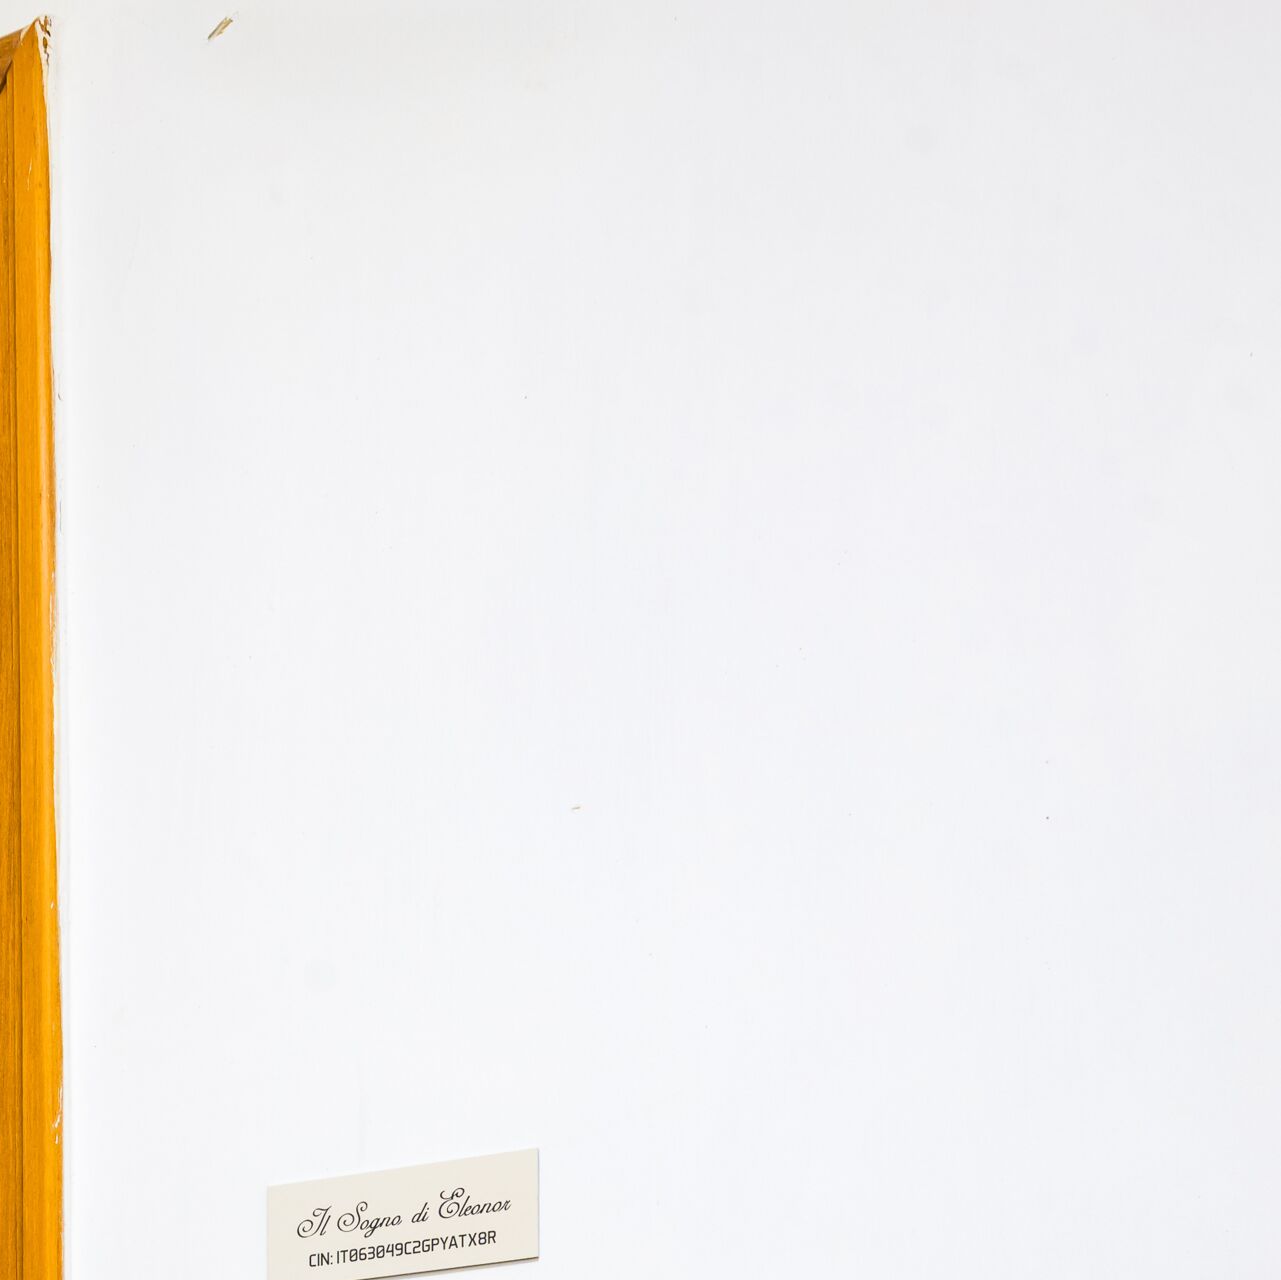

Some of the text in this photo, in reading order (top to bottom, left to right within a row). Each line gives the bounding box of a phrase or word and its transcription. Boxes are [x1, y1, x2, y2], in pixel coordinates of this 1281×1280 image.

[297, 1187, 512, 1238] Il Sogno di Eleonor
[309, 1252, 333, 1268] CIN:
